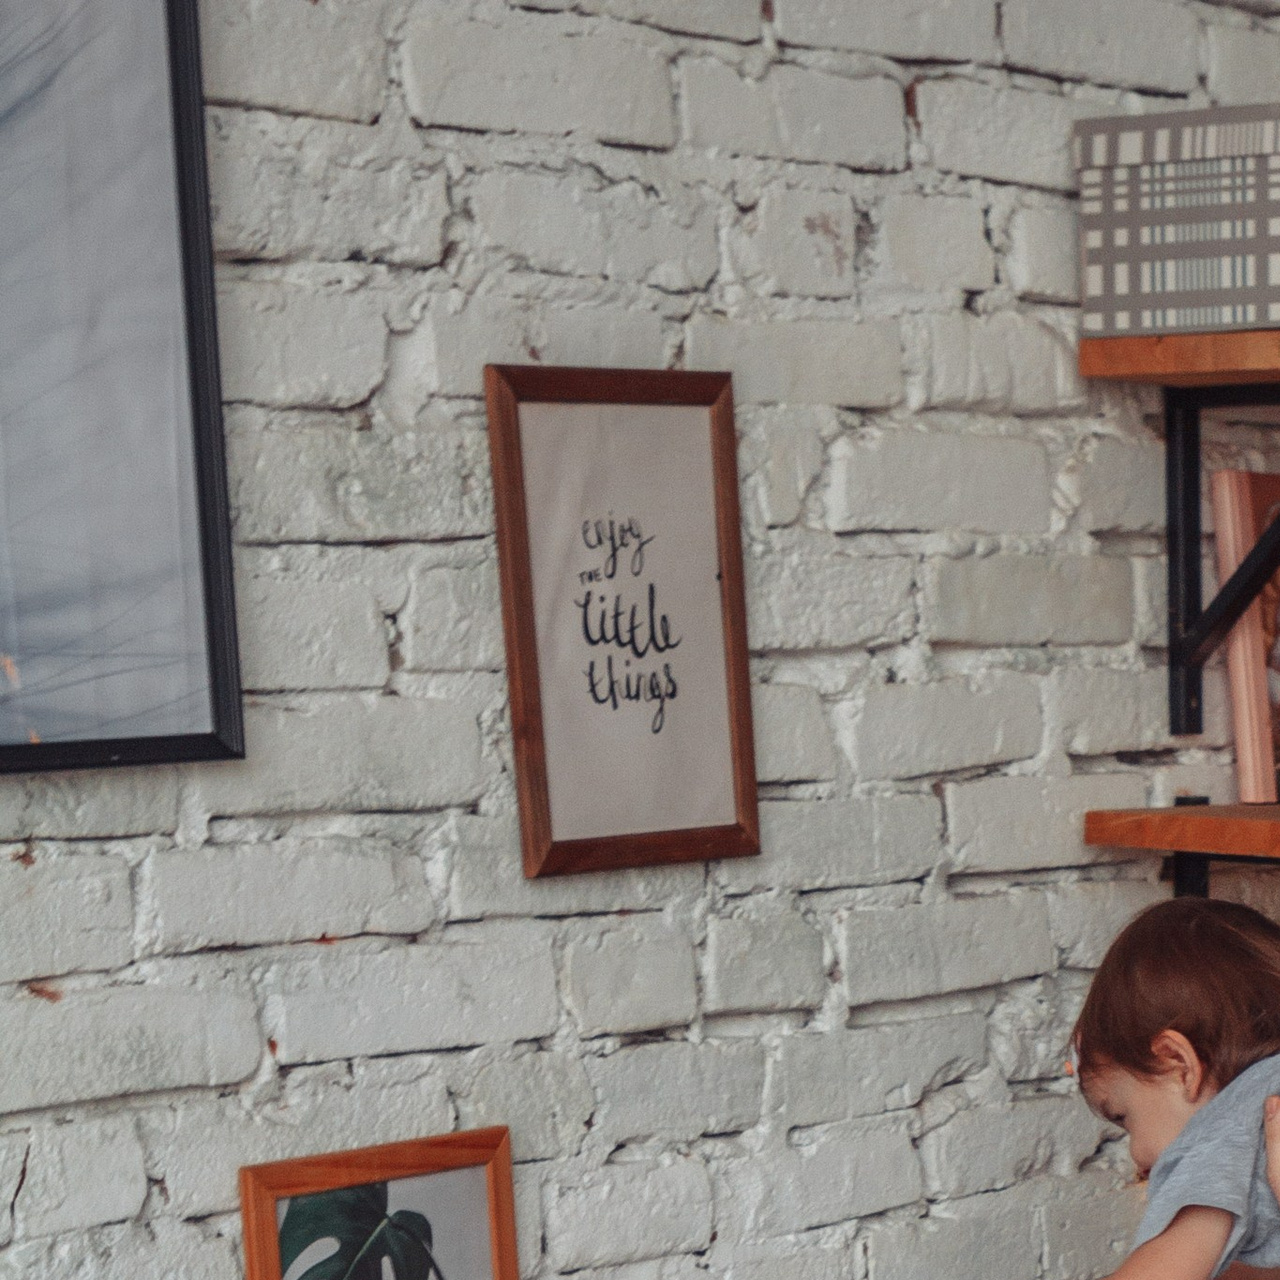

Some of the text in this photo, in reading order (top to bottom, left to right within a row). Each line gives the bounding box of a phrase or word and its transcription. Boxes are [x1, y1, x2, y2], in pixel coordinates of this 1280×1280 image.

[580, 568, 603, 585] THE
[582, 511, 656, 579] enjoy
[574, 583, 683, 658] little
[583, 655, 678, 734] things
